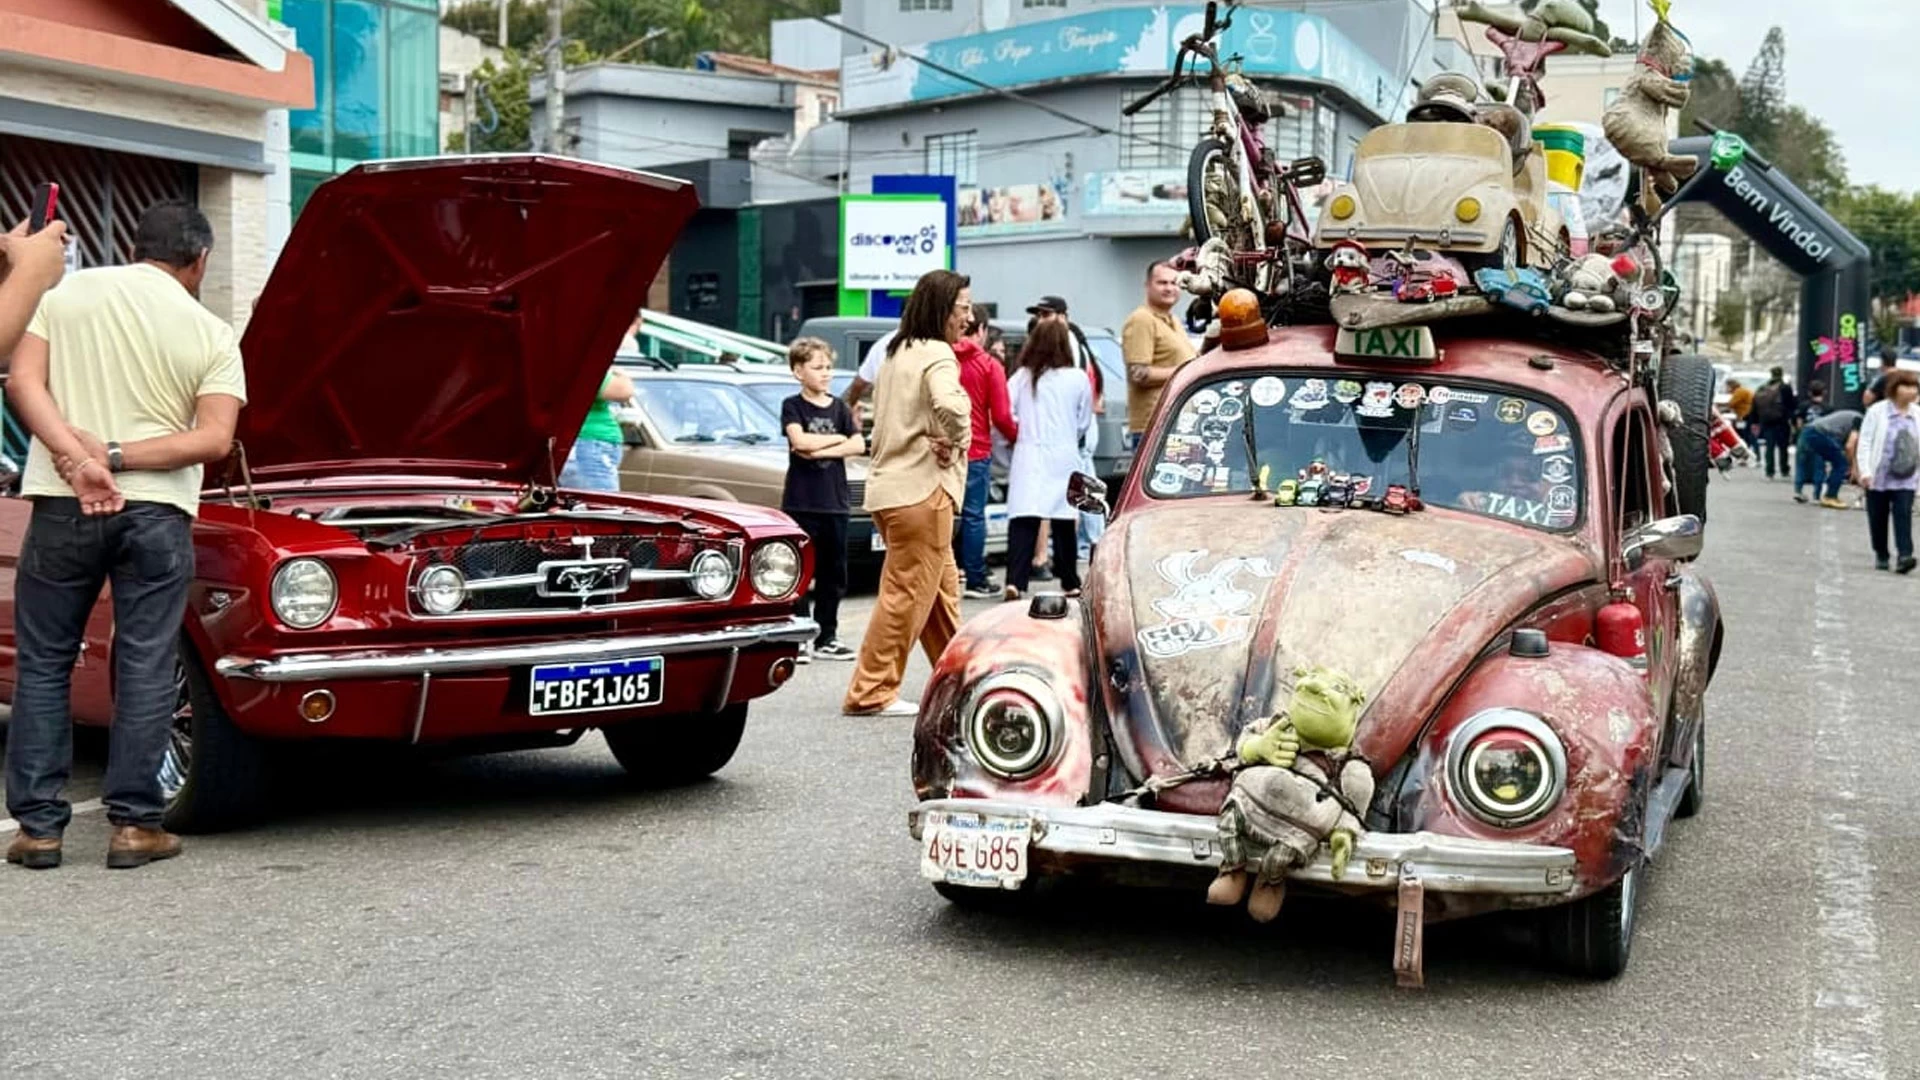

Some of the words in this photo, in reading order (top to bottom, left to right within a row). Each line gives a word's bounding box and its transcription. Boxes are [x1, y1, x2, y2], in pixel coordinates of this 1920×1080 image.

[1723, 166, 1768, 213] Bem
[1768, 202, 1833, 263] Vindo!
[1350, 327, 1420, 356] TAXI
[1487, 492, 1552, 526] TAXI
[543, 673, 651, 709] FBF1J65
[929, 832, 968, 868] 49E
[975, 834, 1020, 872] G85
